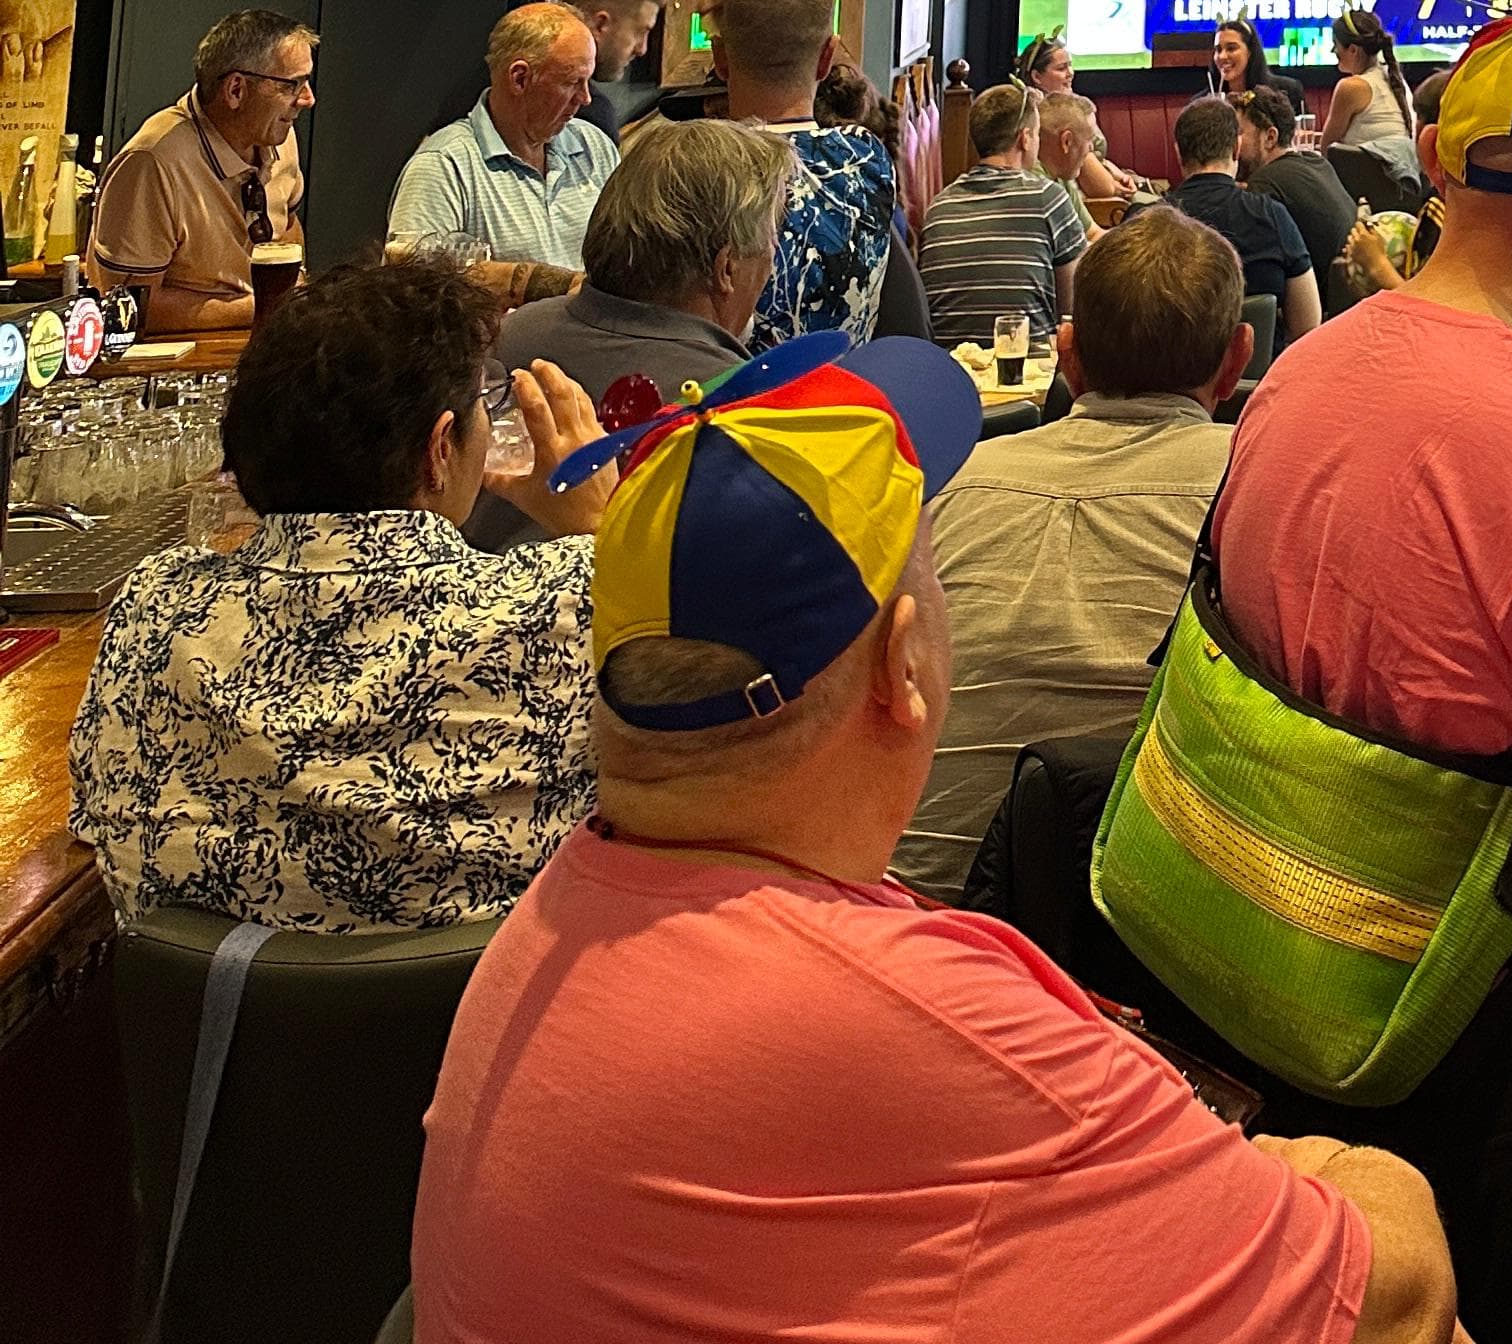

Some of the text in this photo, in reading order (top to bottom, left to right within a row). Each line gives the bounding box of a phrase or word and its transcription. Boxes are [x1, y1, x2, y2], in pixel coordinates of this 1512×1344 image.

[22, 100, 46, 110] LIMB
[0, 122, 58, 132] VER BEFALL
